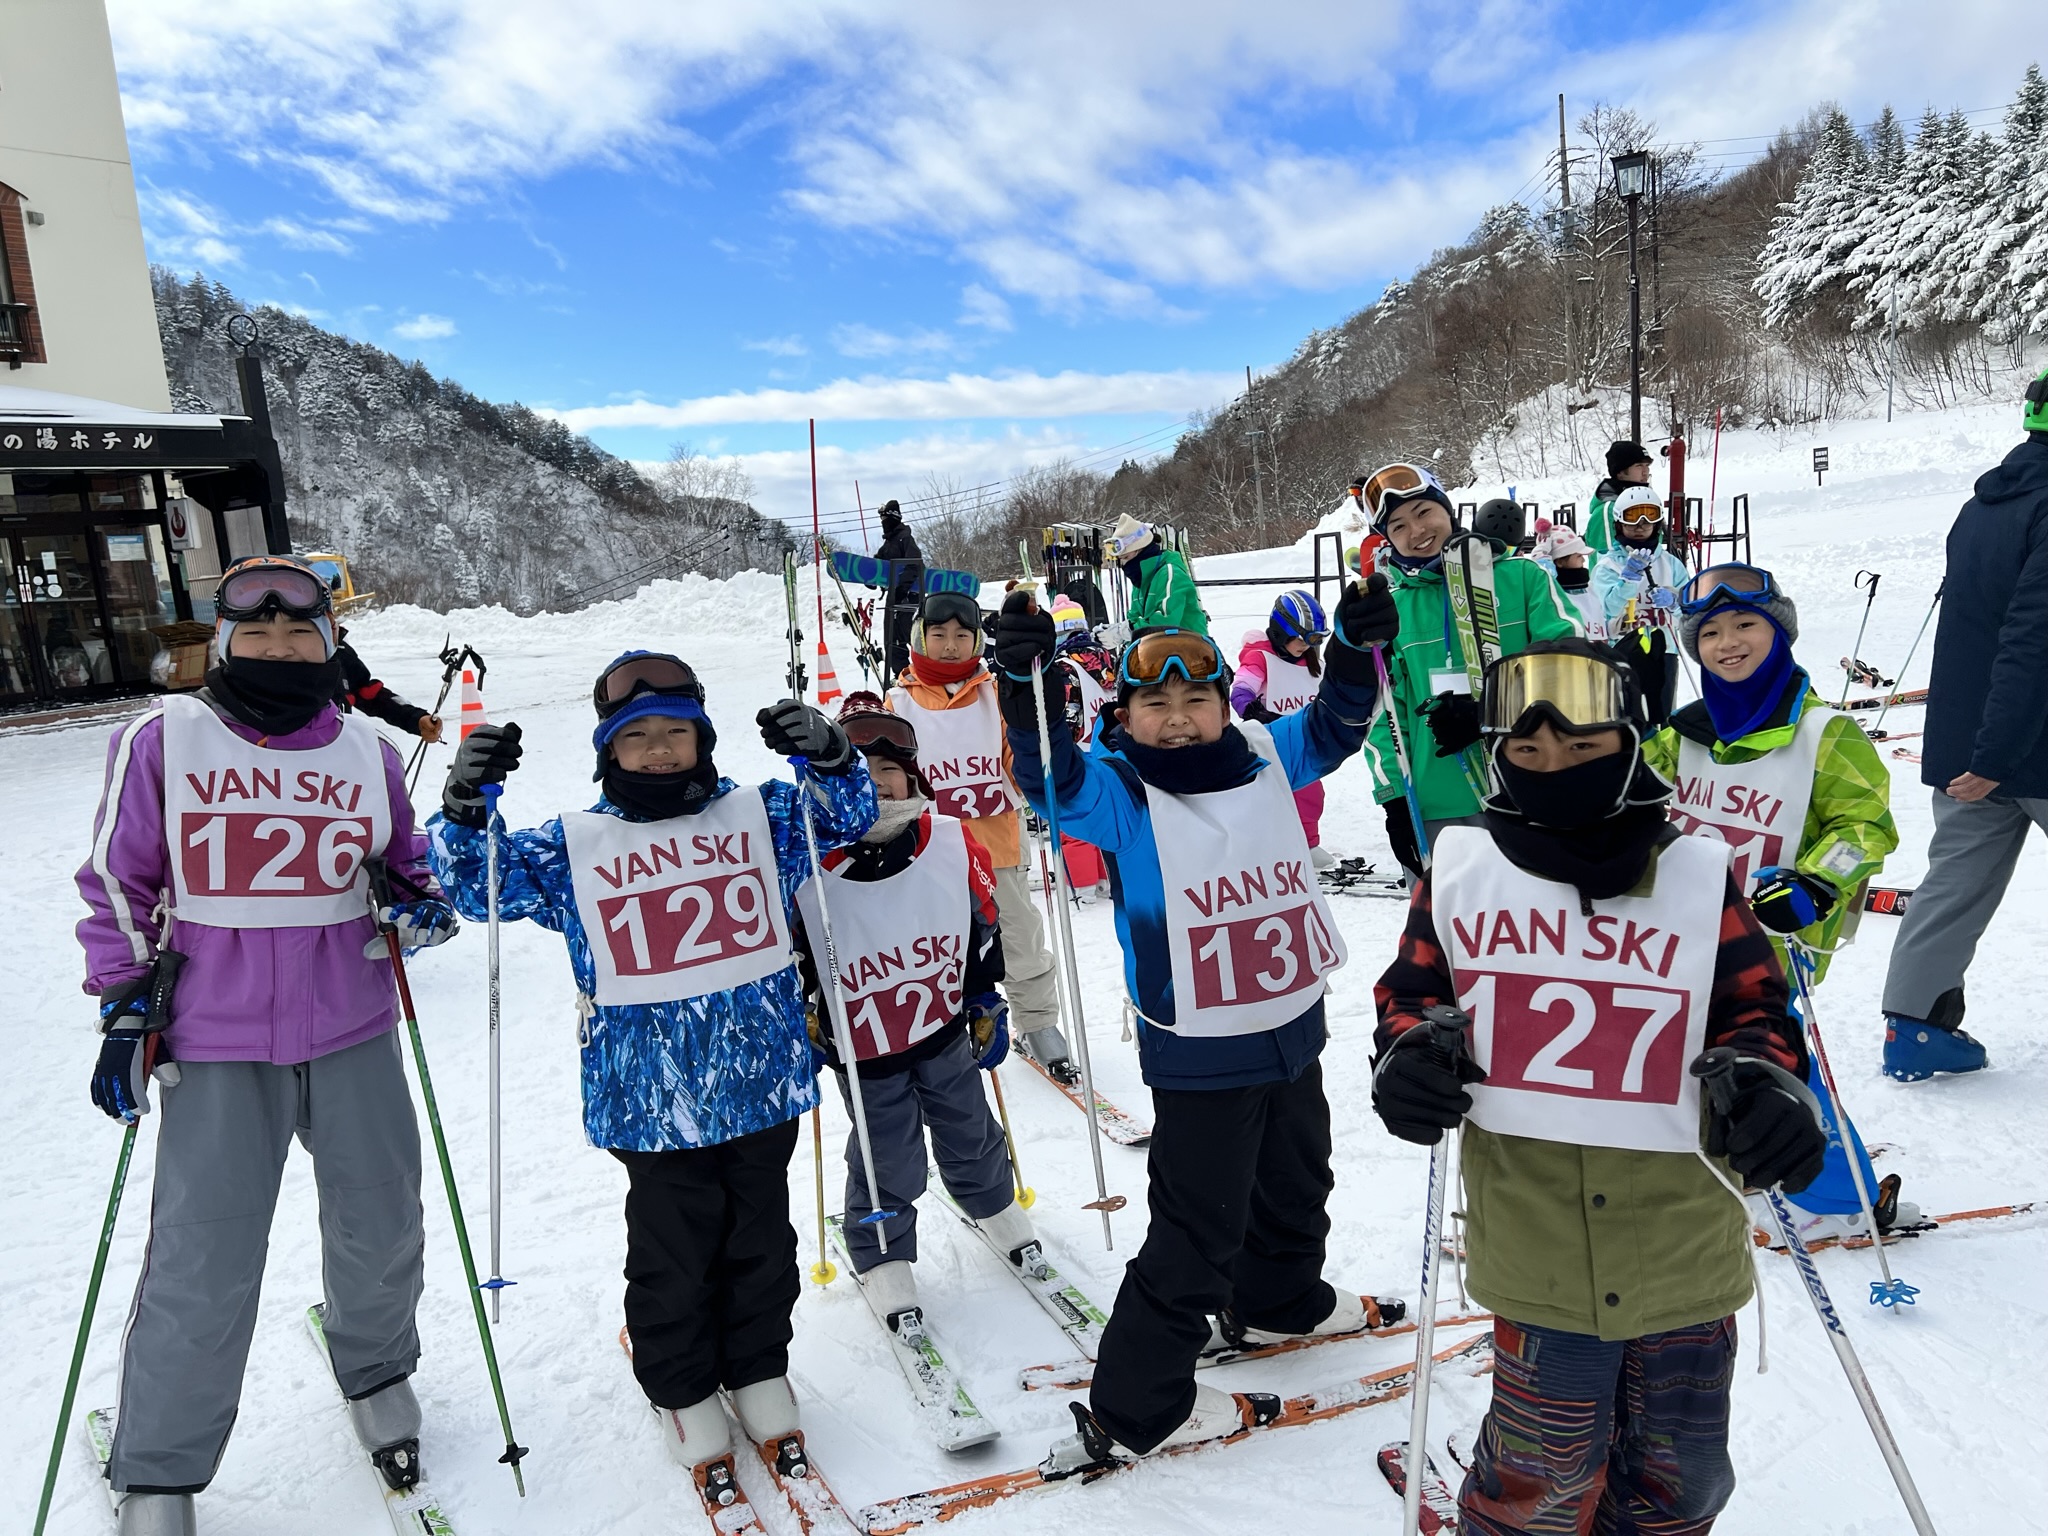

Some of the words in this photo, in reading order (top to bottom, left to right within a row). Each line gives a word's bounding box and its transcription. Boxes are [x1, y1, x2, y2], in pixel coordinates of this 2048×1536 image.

[3, 427, 153, 450] の湯ホテル
[1273, 695, 1304, 713] VAN
[185, 767, 282, 805] VAN
[293, 770, 363, 813] SKI
[966, 756, 1001, 777] SKI
[1675, 775, 1715, 809] VAN
[1721, 785, 1784, 828] SKI
[188, 815, 367, 891] 126
[592, 837, 682, 889] VAN
[691, 831, 750, 866] SKI
[1183, 866, 1269, 918] VAN
[1273, 860, 1309, 897] SK
[1756, 881, 1783, 898] reusch
[609, 874, 770, 970] 129
[1452, 908, 1567, 960] VAN
[1581, 914, 1681, 979] SKI
[839, 946, 905, 994] VAN
[912, 934, 960, 969] SKI
[1199, 904, 1337, 1002] 130
[852, 963, 963, 1055] 128
[1457, 974, 1683, 1094] 127
